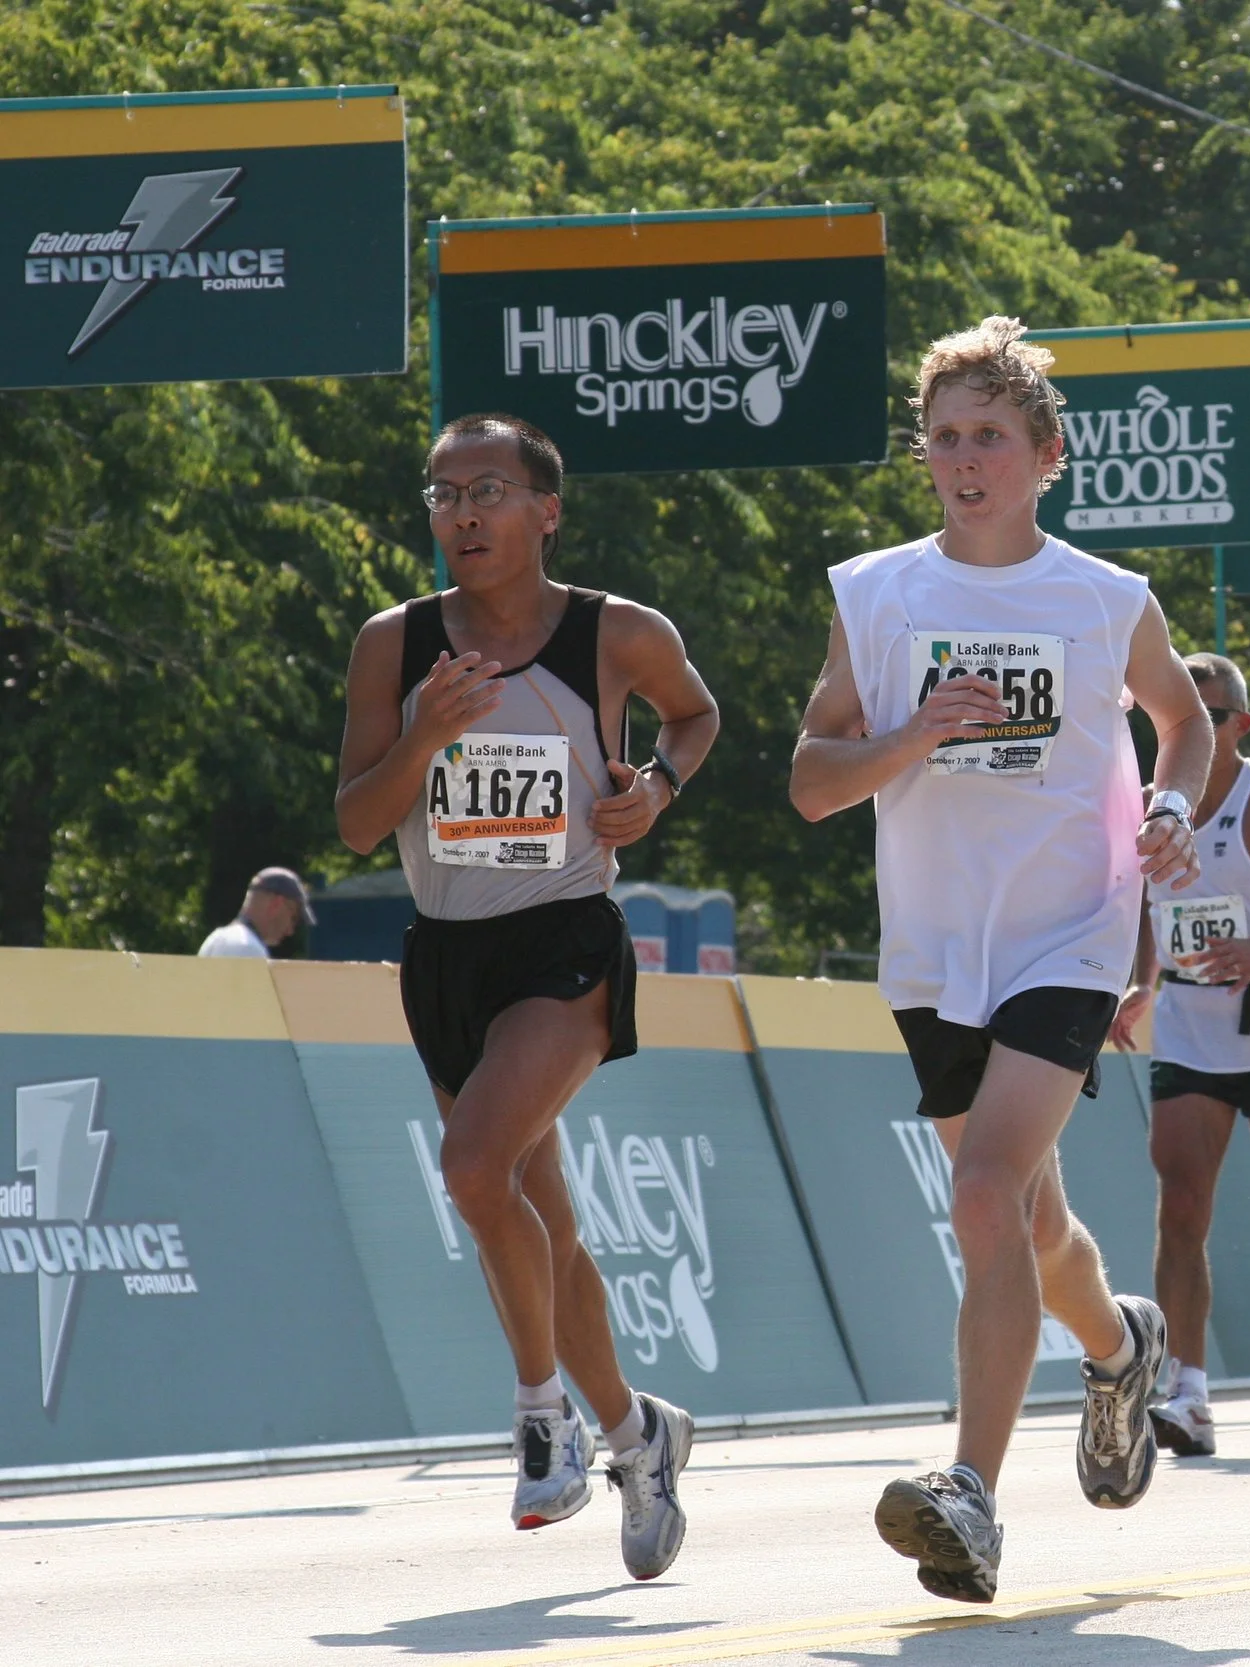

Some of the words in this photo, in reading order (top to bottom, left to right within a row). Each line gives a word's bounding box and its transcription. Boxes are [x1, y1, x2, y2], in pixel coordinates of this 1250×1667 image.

[28, 229, 131, 254] Gatorade
[24, 247, 285, 285] ENDURANCE
[202, 276, 285, 291] FORMULA
[575, 373, 738, 427] Springs
[1063, 402, 1235, 457] WHOLE
[1070, 453, 1228, 506] FOODS
[1078, 506, 1221, 525] MARKET
[957, 642, 1004, 656] LaSalle
[1008, 643, 1041, 657] Bank
[957, 659, 973, 667] ABN
[974, 659, 998, 667] AMRO
[947, 667, 1054, 722] 58
[468, 744, 513, 757] LaSalle
[516, 744, 546, 757] Bank
[964, 757, 981, 765] 2007
[468, 759, 483, 767] ABN
[429, 767, 450, 815] A
[465, 768, 563, 819] 1673
[450, 826, 471, 837] 30th
[474, 820, 557, 836] ANNIVERSARY
[475, 850, 490, 858] 2007
[1171, 923, 1184, 953] A
[0, 1223, 190, 1274] DURANCE
[123, 1273, 198, 1295] FORMULA
